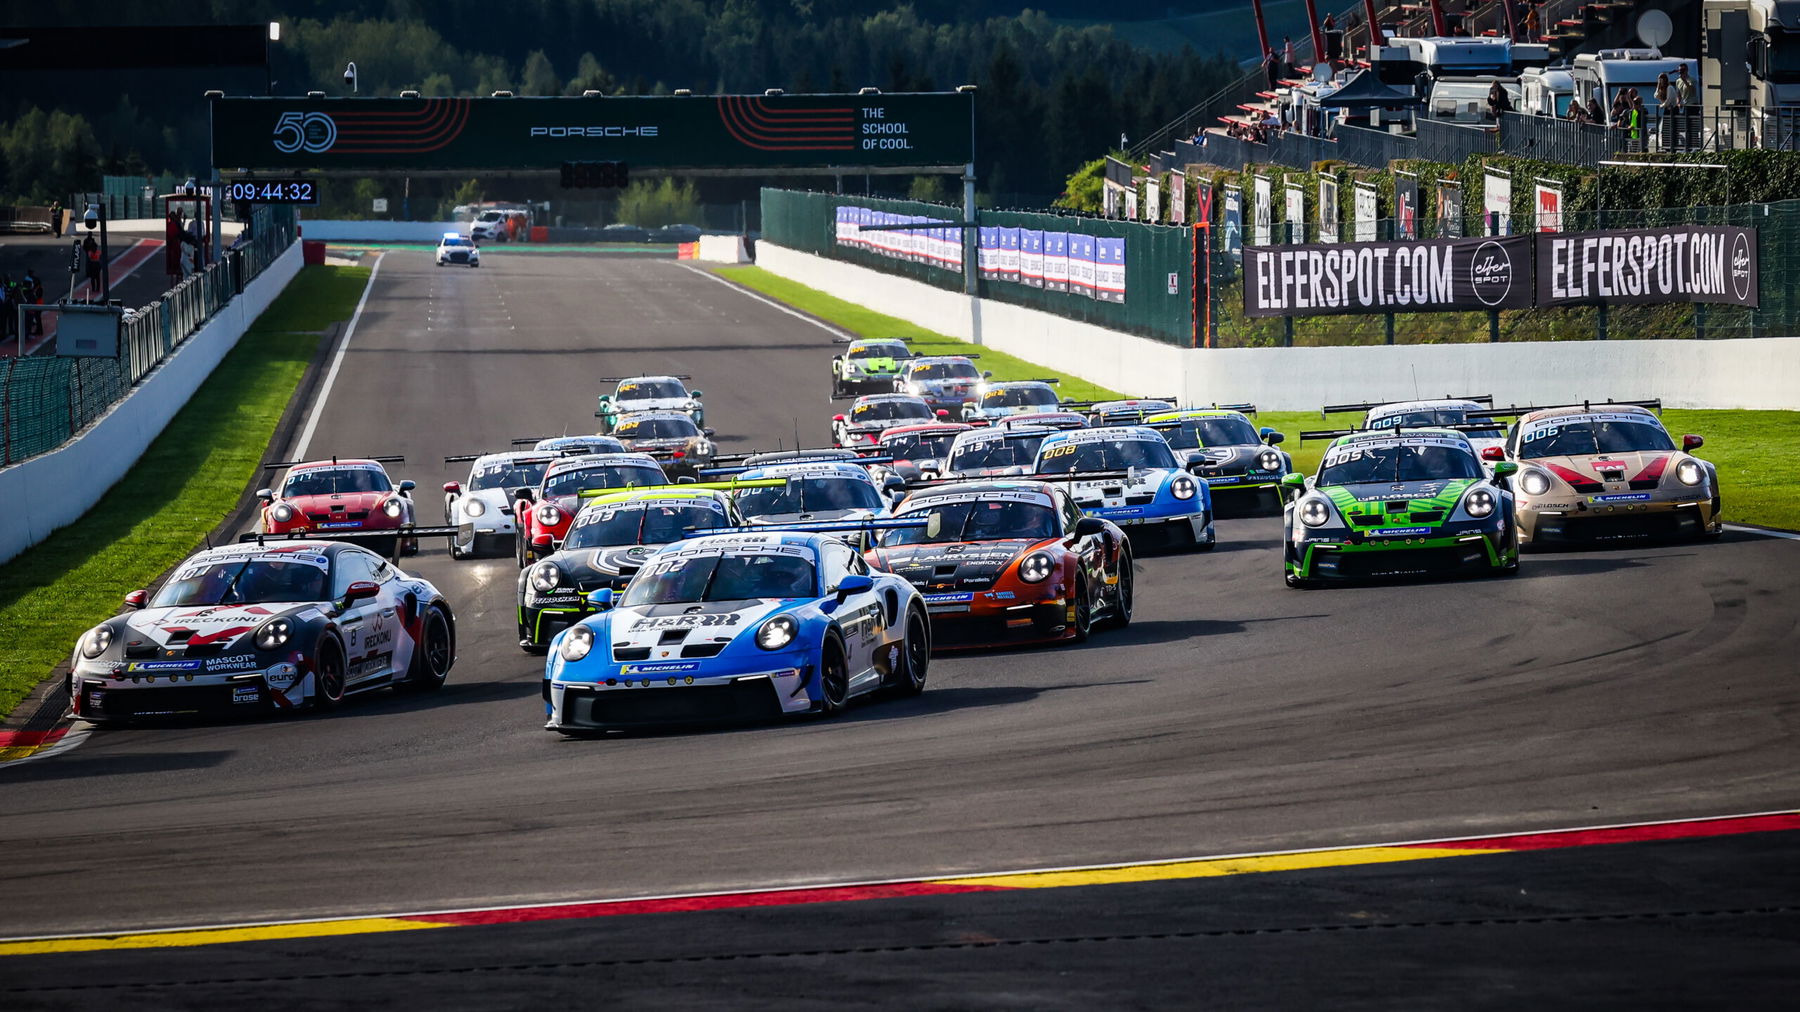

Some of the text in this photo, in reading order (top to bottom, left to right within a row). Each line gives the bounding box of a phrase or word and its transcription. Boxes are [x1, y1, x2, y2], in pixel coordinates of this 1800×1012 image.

[862, 108, 885, 119] THE
[274, 112, 338, 153] 50
[530, 126, 659, 138] PORSCHE
[862, 123, 909, 134] SCHOOL
[862, 138, 913, 150] OF COOL.
[233, 182, 312, 200] 09:44:32
[1551, 232, 1726, 298] ELFERSPOT.COM
[1256, 245, 1454, 308] ELFERSPOT.COM
[1475, 276, 1508, 284] SPOT
[1733, 269, 1750, 277] SPOT
[1372, 415, 1402, 430] 009
[1535, 414, 1646, 428] PORSCHE
[1052, 434, 1154, 447] PORSCHE
[1524, 426, 1559, 445] 006
[1340, 437, 1457, 451] PORSCHE
[1043, 445, 1077, 460] 008
[1325, 450, 1362, 468] 005
[558, 459, 648, 470] PORSCHE
[592, 499, 709, 513] PORSCHE
[911, 492, 1036, 507] PORSCHE
[576, 510, 615, 528] 003
[192, 552, 317, 566] PORSCHE
[660, 546, 801, 561] PORSCHE
[913, 552, 1014, 563] LAURYSSEN
[641, 558, 690, 579] 002
[173, 616, 264, 625] IRECKONU
[631, 615, 699, 629] H&R
[206, 661, 257, 672] WORKWEAR
[233, 693, 260, 702] brose
